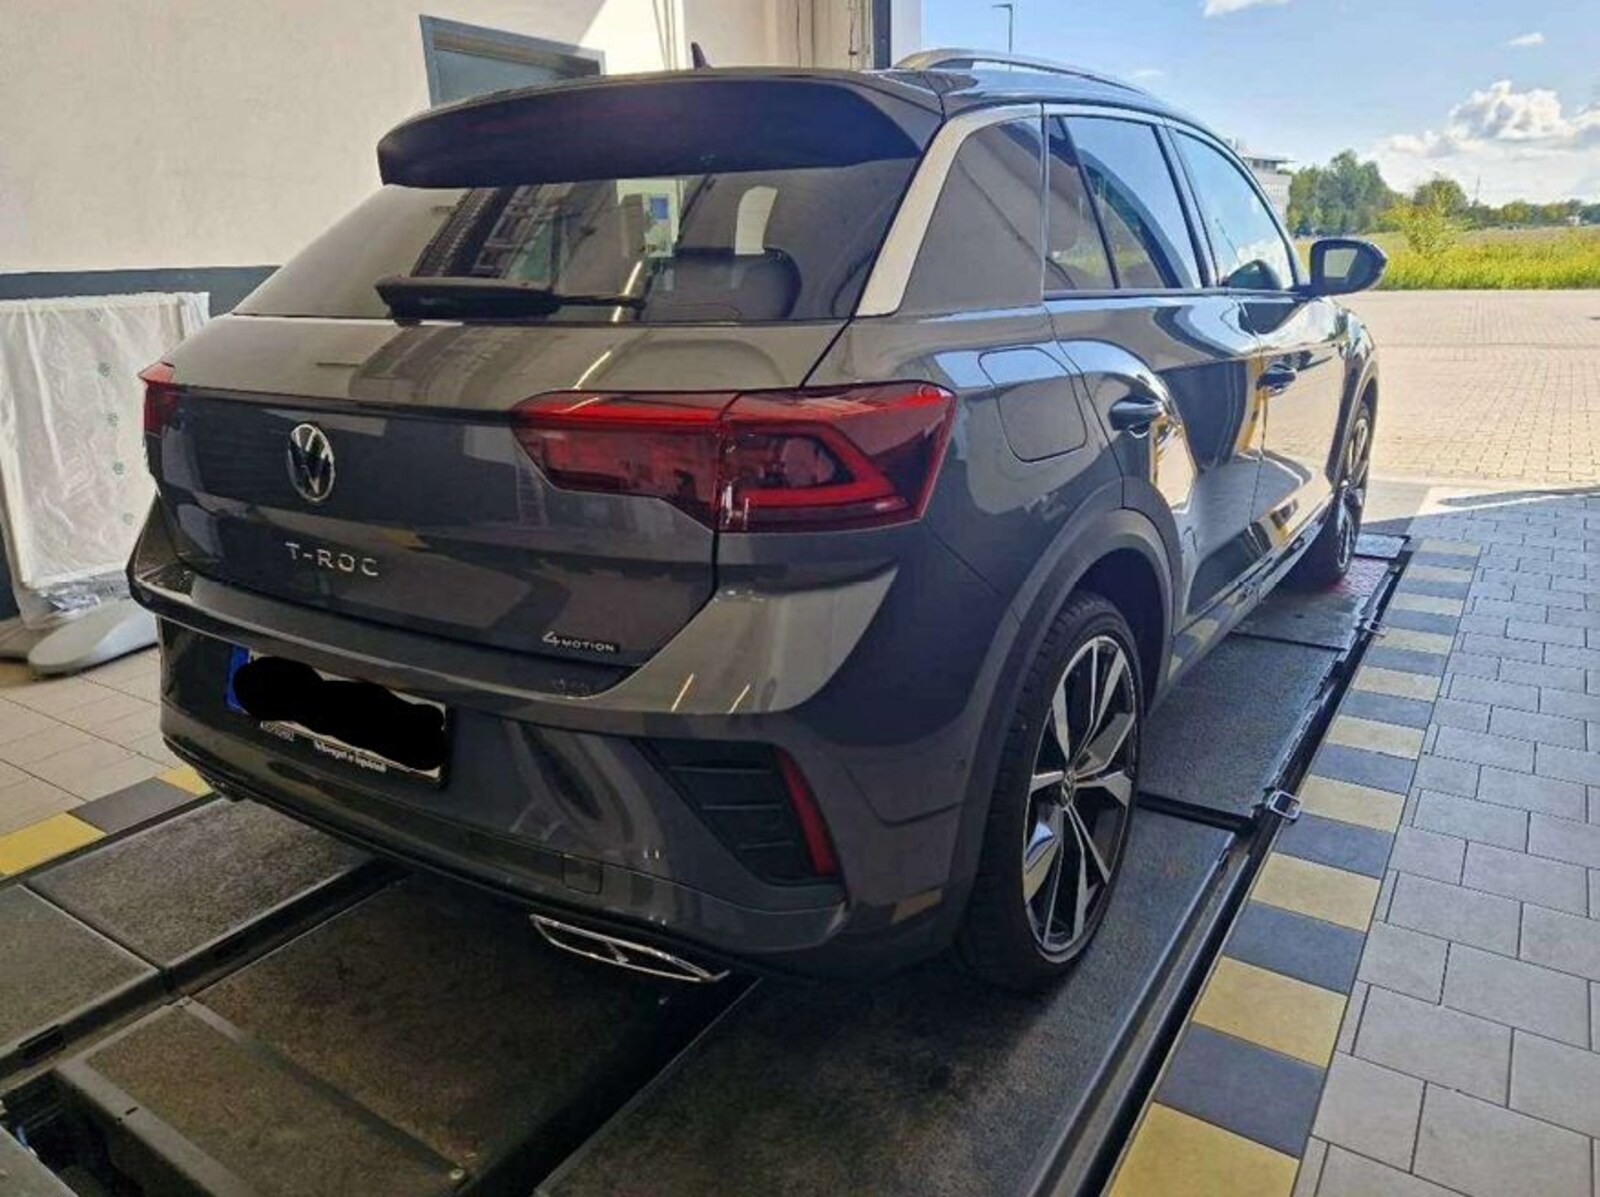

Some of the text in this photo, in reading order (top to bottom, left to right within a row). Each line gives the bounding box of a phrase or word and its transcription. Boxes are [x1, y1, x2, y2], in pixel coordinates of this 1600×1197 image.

[288, 423, 335, 503] VW
[284, 541, 380, 577] T-ROC
[541, 630, 615, 653] 4MOTION
